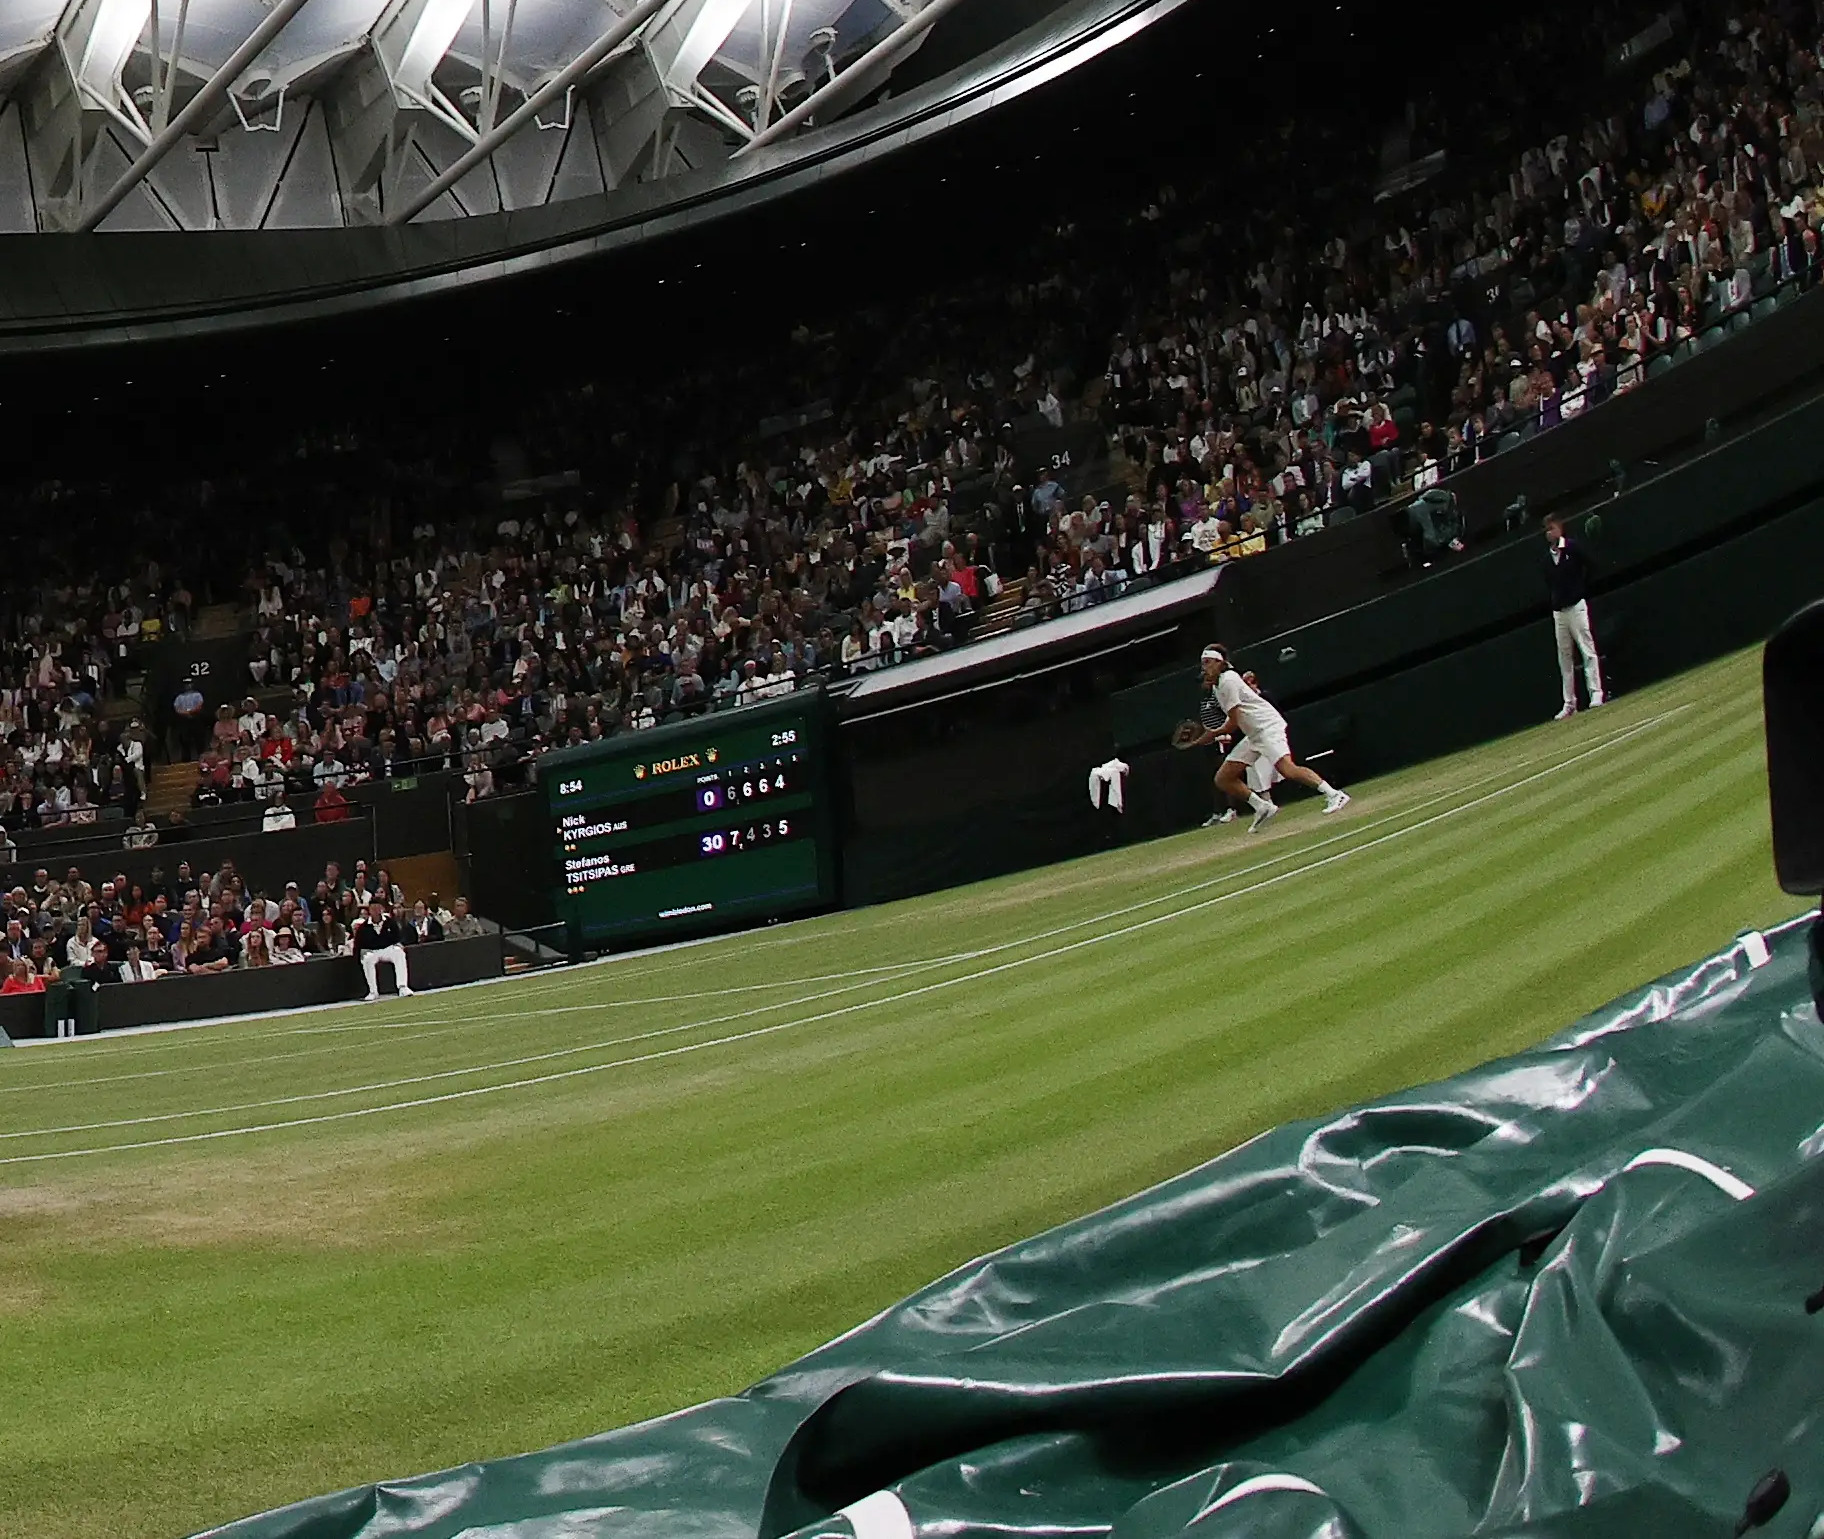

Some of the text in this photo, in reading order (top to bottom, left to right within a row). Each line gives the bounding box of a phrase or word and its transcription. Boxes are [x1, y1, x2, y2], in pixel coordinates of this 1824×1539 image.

[1052, 450, 1071, 470] 34
[190, 661, 210, 676] 32
[771, 730, 796, 746] 2:55
[651, 753, 701, 775] ROLEX
[559, 780, 583, 795] 8:54
[563, 822, 612, 841] KYRGIOS
[612, 820, 628, 831] AUS
[704, 790, 715, 806] 0
[727, 786, 736, 800] 6
[742, 781, 753, 797] 6
[758, 778, 769, 793] 6
[774, 774, 786, 789] 4
[562, 814, 586, 828] Nick
[565, 864, 619, 884] TSITSIPAS
[619, 863, 636, 874] GRE
[702, 834, 723, 852] 30
[729, 830, 740, 846] 7
[746, 826, 755, 842] 4
[762, 823, 772, 838] 3
[778, 820, 788, 835] 5
[565, 854, 610, 871] Stefanos
